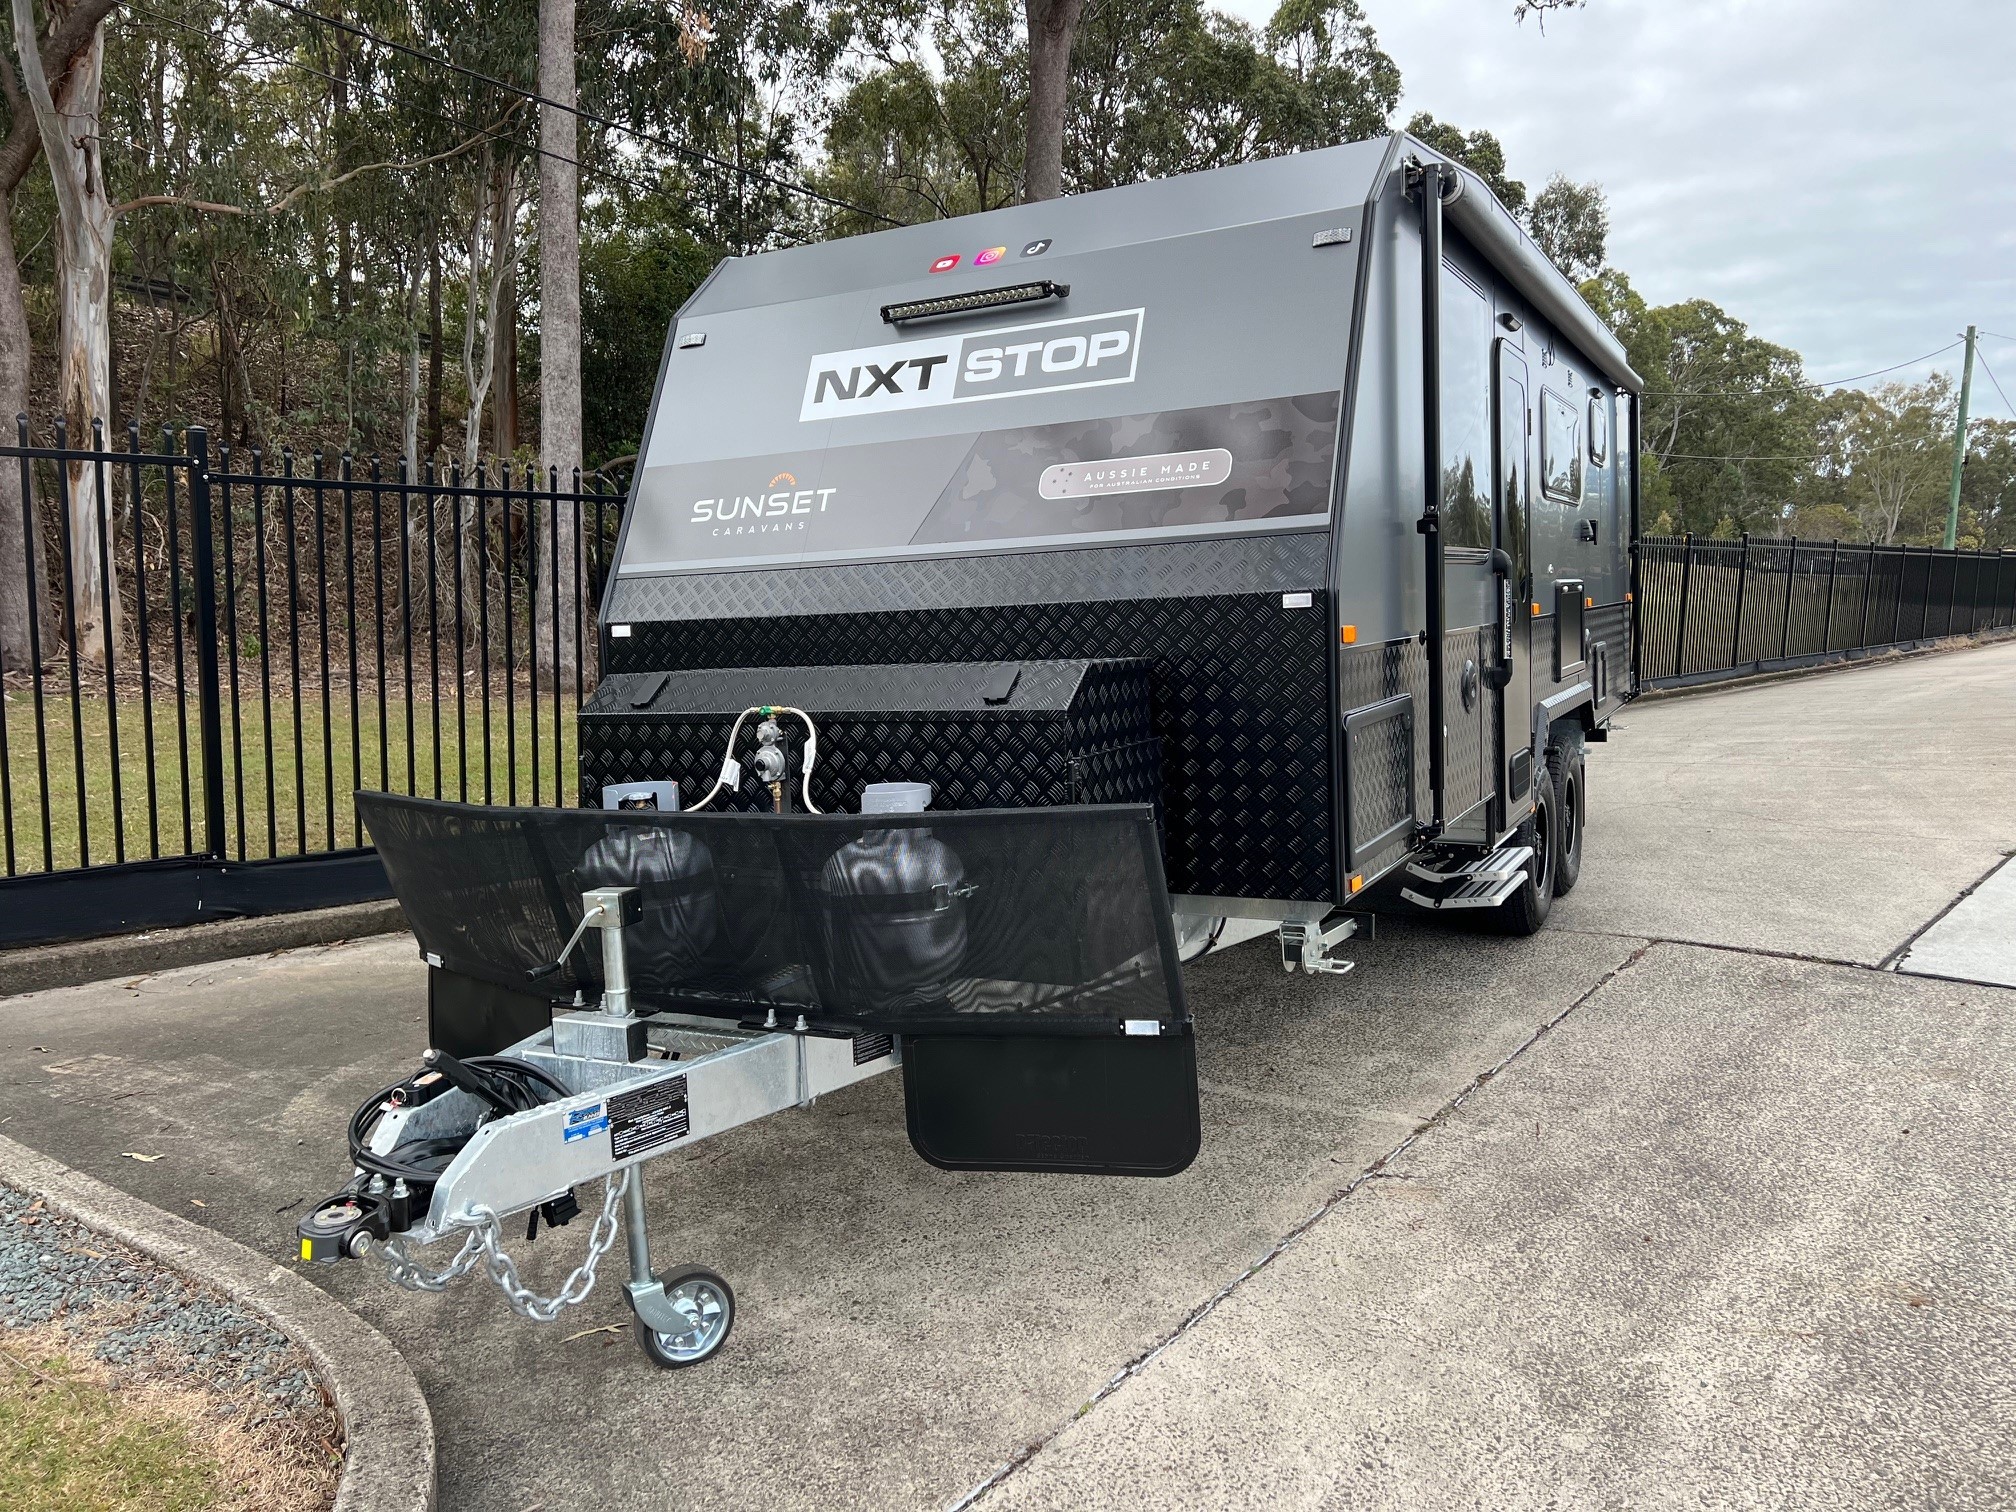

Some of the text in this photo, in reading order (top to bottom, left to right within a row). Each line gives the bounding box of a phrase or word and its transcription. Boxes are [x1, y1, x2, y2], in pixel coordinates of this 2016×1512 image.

[813, 330, 1130, 404] NXT STOP
[1083, 460, 1211, 482] AUSSIE MADE
[1089, 474, 1201, 489] FOR AUSTRALIAN CONDITIONS
[690, 487, 837, 537] SUNSET CARAVANS
